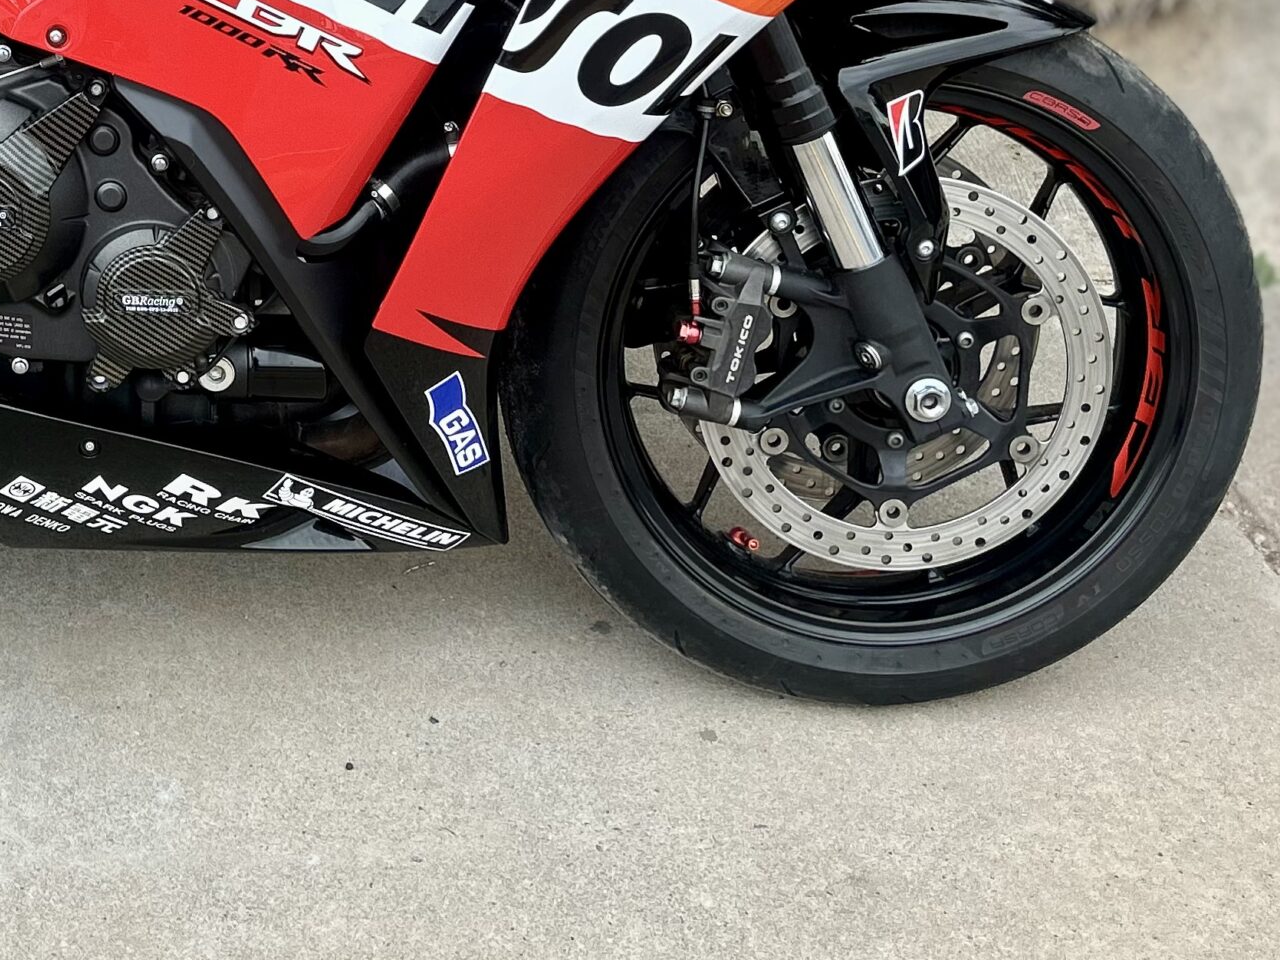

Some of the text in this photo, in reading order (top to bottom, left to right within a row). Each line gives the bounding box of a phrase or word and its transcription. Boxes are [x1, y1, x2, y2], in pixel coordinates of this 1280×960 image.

[1028, 91, 1092, 127] CORSA
[725, 313, 754, 384] TOKICO
[438, 408, 483, 468] GAS
[73, 491, 178, 533] SPARK PLUGS
[81, 474, 199, 528] NGK
[156, 490, 257, 525] RACING CHAIN
[162, 473, 278, 519] RK
[24, 513, 72, 533] DENKO
[321, 497, 462, 546] MICHELIN
